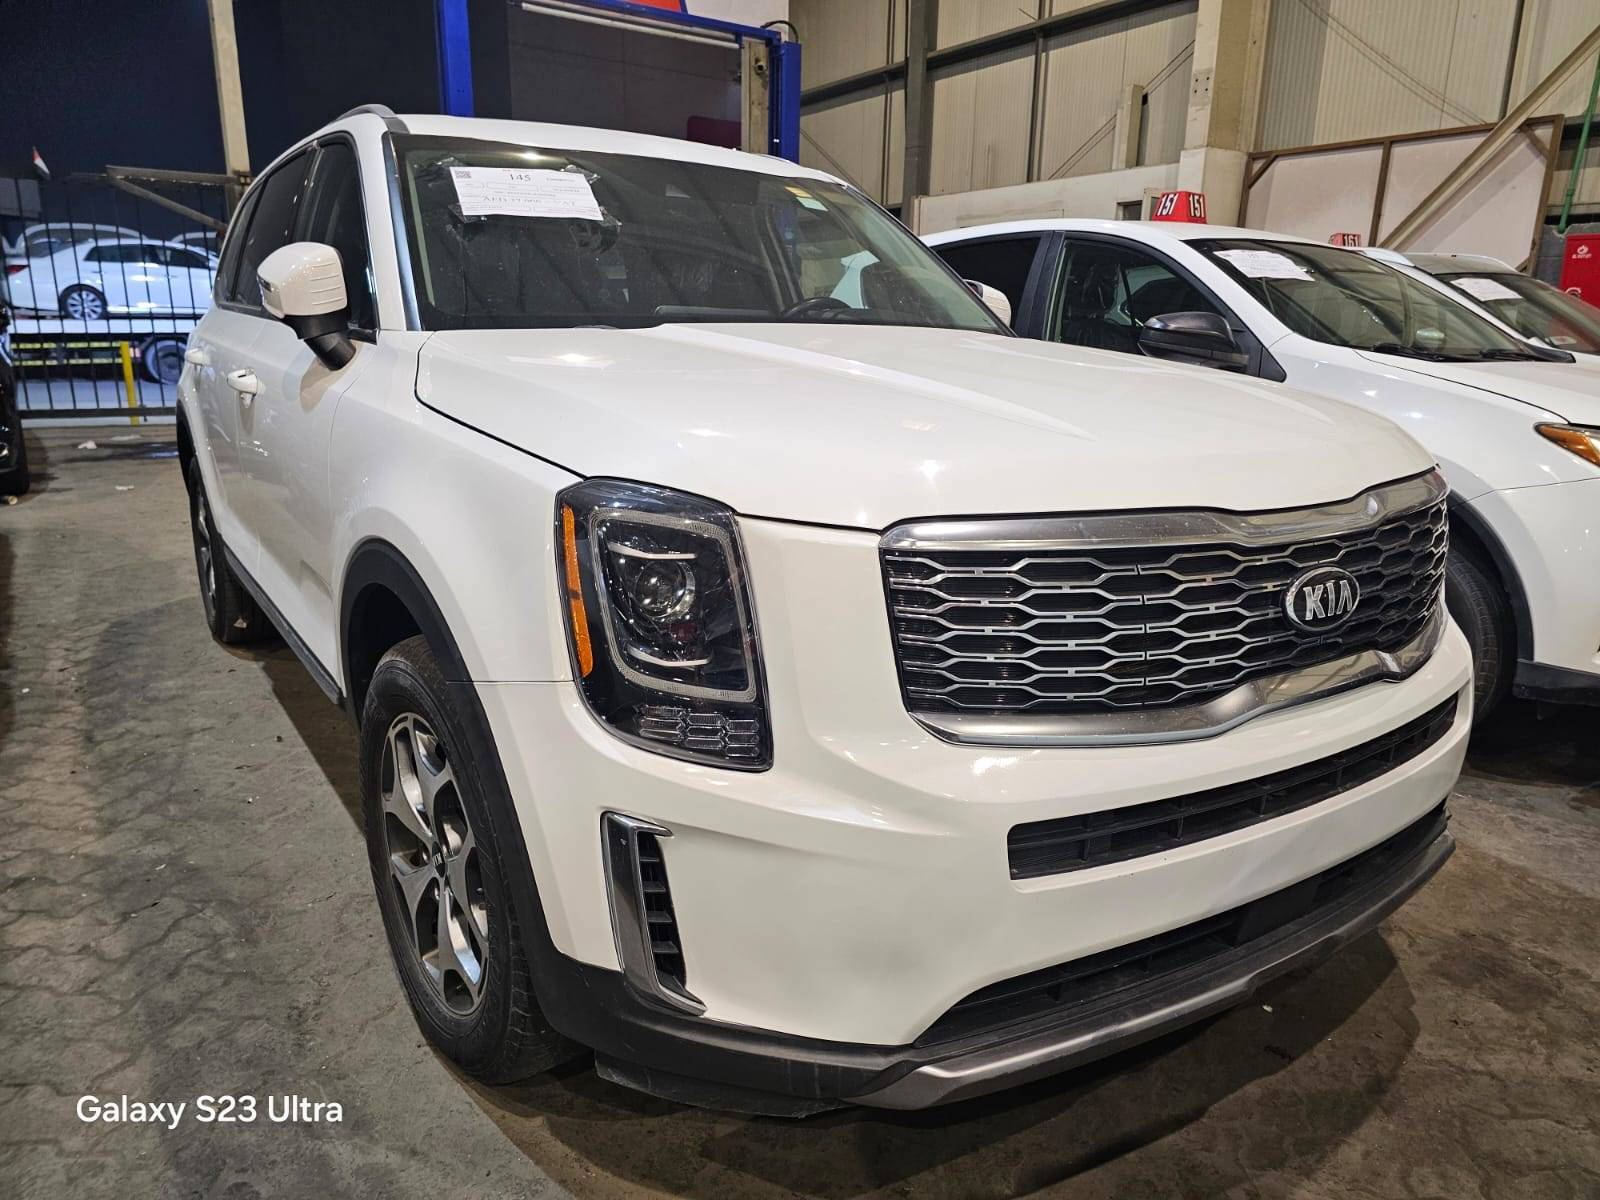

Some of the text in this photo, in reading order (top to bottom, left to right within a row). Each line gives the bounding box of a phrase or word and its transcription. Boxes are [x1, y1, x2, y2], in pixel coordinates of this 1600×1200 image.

[510, 173, 532, 183] 145
[1157, 193, 1179, 216] 151
[1189, 194, 1205, 218] 151
[1303, 580, 1352, 620] KIA
